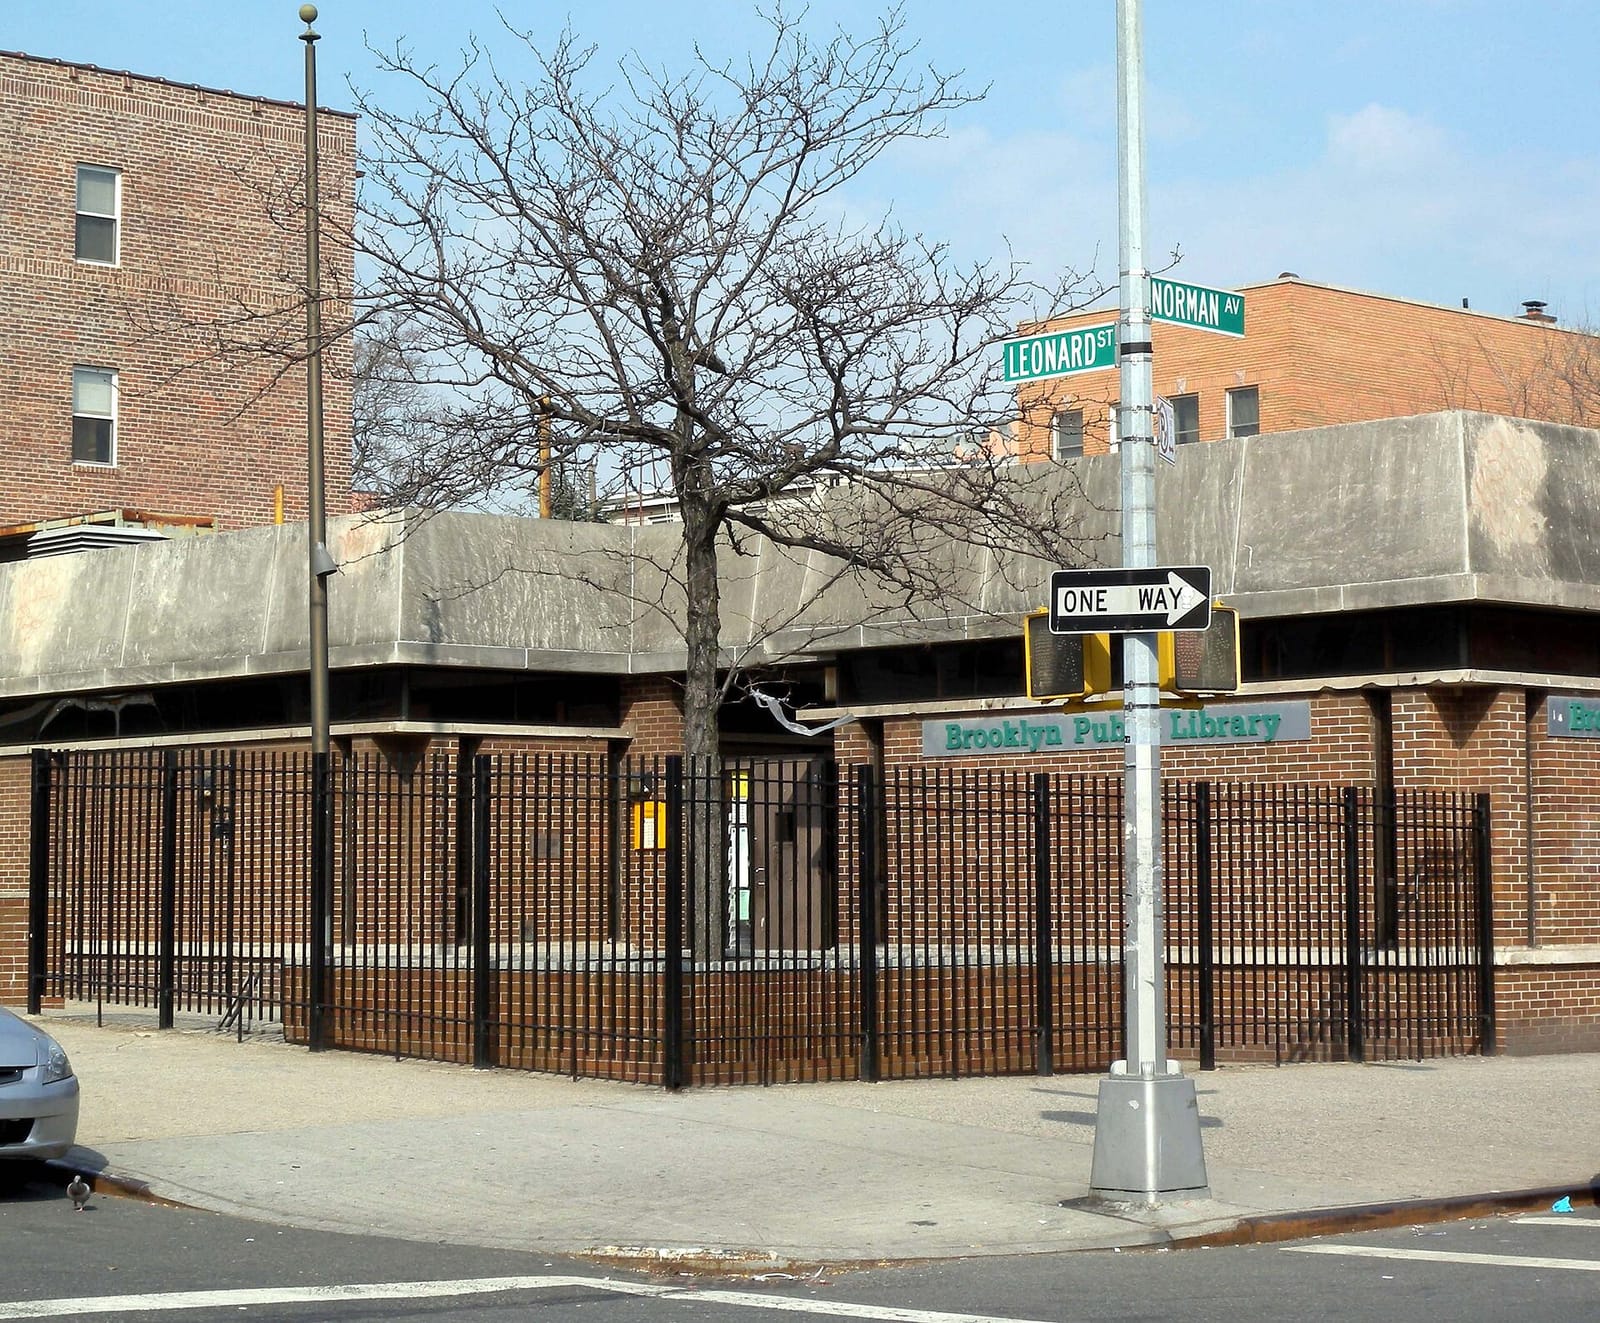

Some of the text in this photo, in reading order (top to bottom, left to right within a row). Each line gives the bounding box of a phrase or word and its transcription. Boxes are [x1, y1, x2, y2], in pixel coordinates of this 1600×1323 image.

[1151, 281, 1240, 326] NORMAN AV
[1009, 328, 1114, 378] LEONARD ST
[1064, 587, 1182, 613] ONE WAY
[945, 709, 1281, 752] Brooklyn Pub Library
